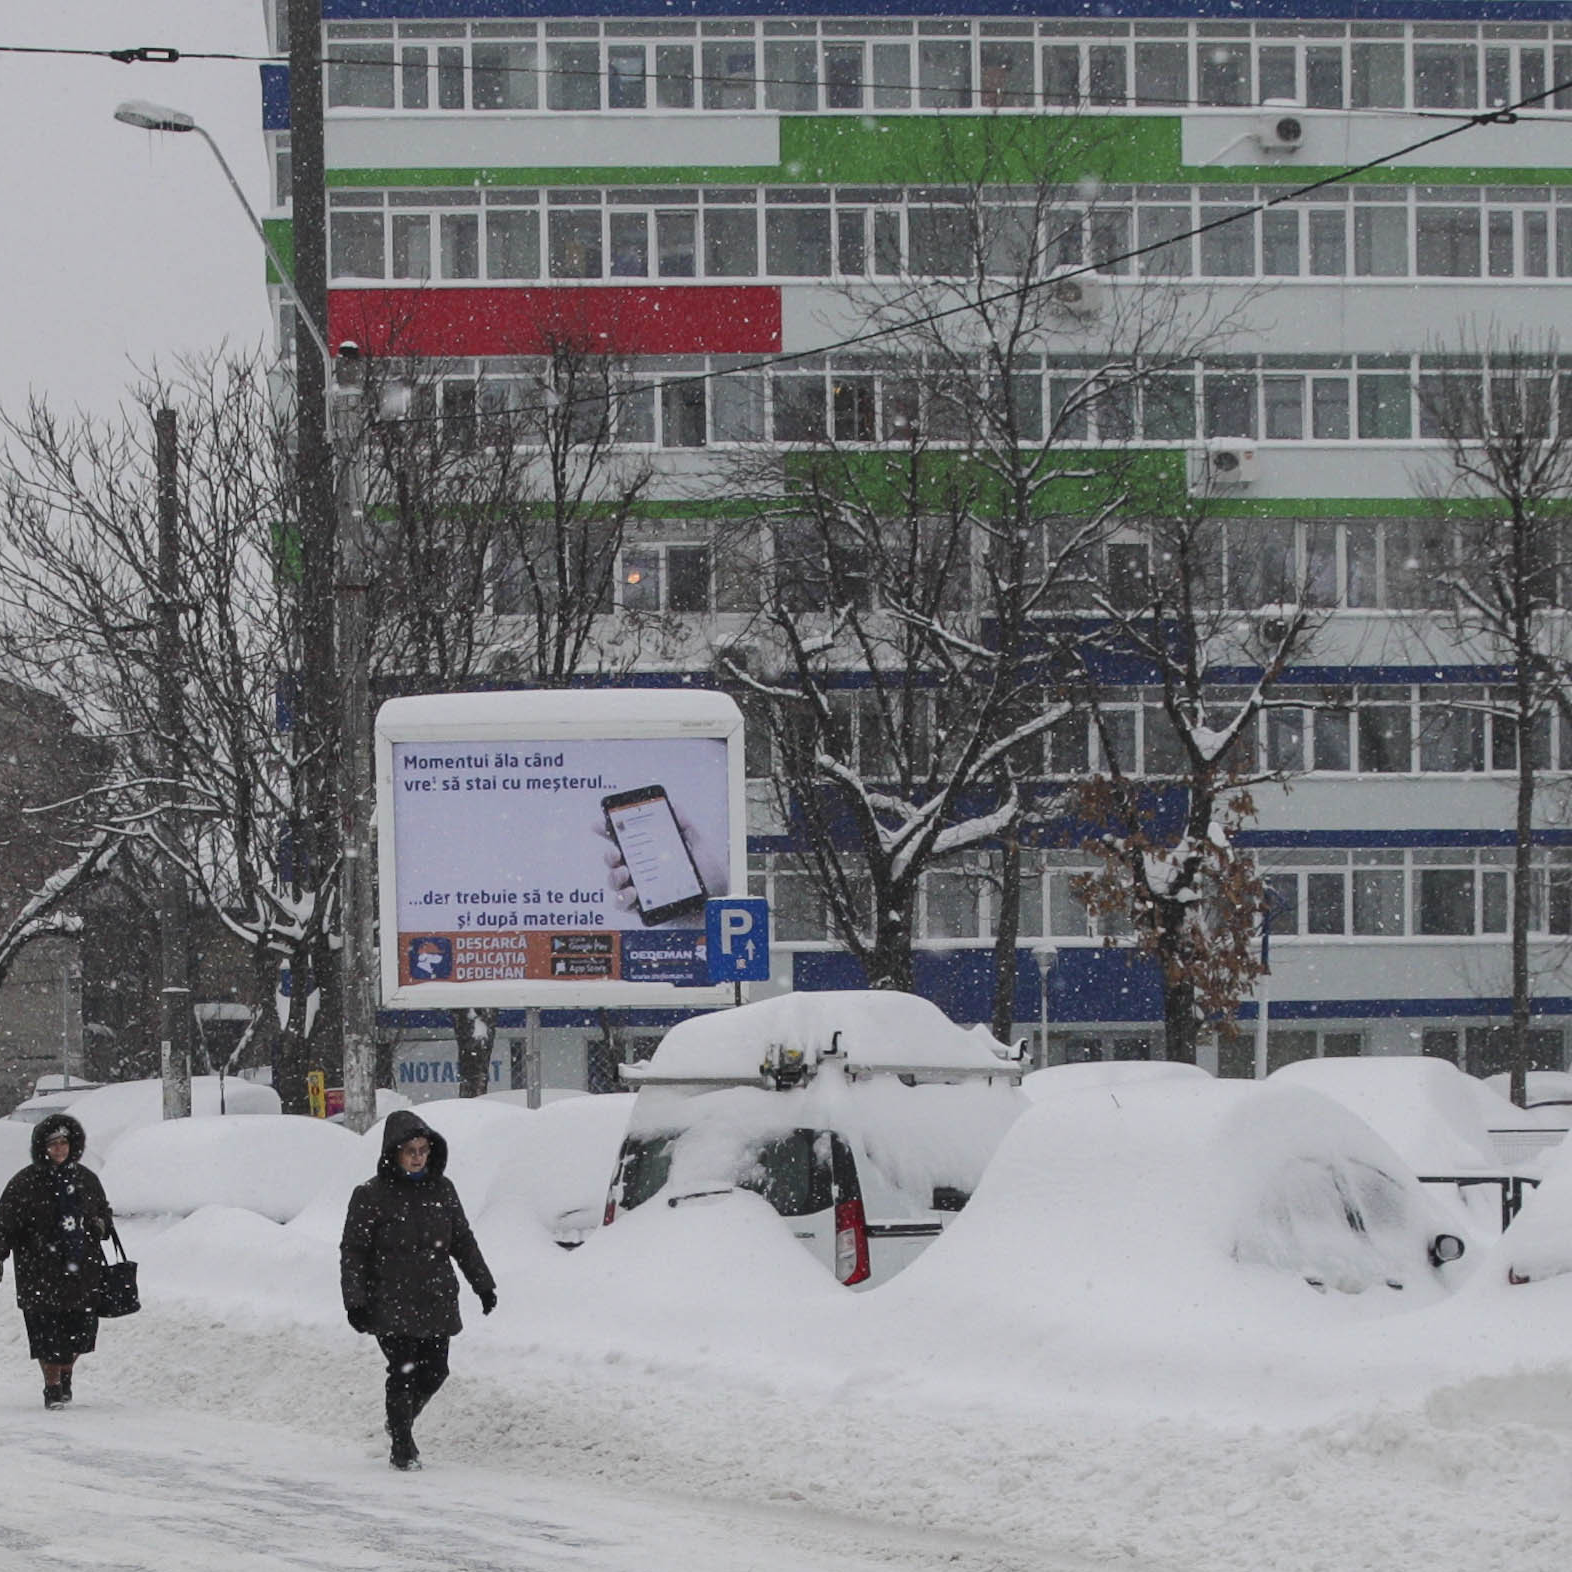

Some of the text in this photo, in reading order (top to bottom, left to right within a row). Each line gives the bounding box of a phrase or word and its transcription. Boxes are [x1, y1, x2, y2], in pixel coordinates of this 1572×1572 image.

[494, 752, 519, 769] ăla
[524, 752, 564, 768] când
[442, 775, 460, 791] să
[465, 775, 497, 791] stai
[502, 779, 521, 790] cu
[456, 890, 517, 905] trebuie
[523, 890, 541, 904] să
[547, 890, 564, 904] te
[569, 889, 604, 904] duci
[477, 911, 518, 929] după
[524, 910, 604, 926] materiale
[720, 908, 753, 955] P
[455, 935, 527, 950] DESCARCĂ
[455, 952, 527, 967] APLICAȚIA
[630, 950, 693, 961] DEDEMAN
[456, 967, 525, 980] DEDEMAN
[399, 1060, 503, 1083] NOTAT
